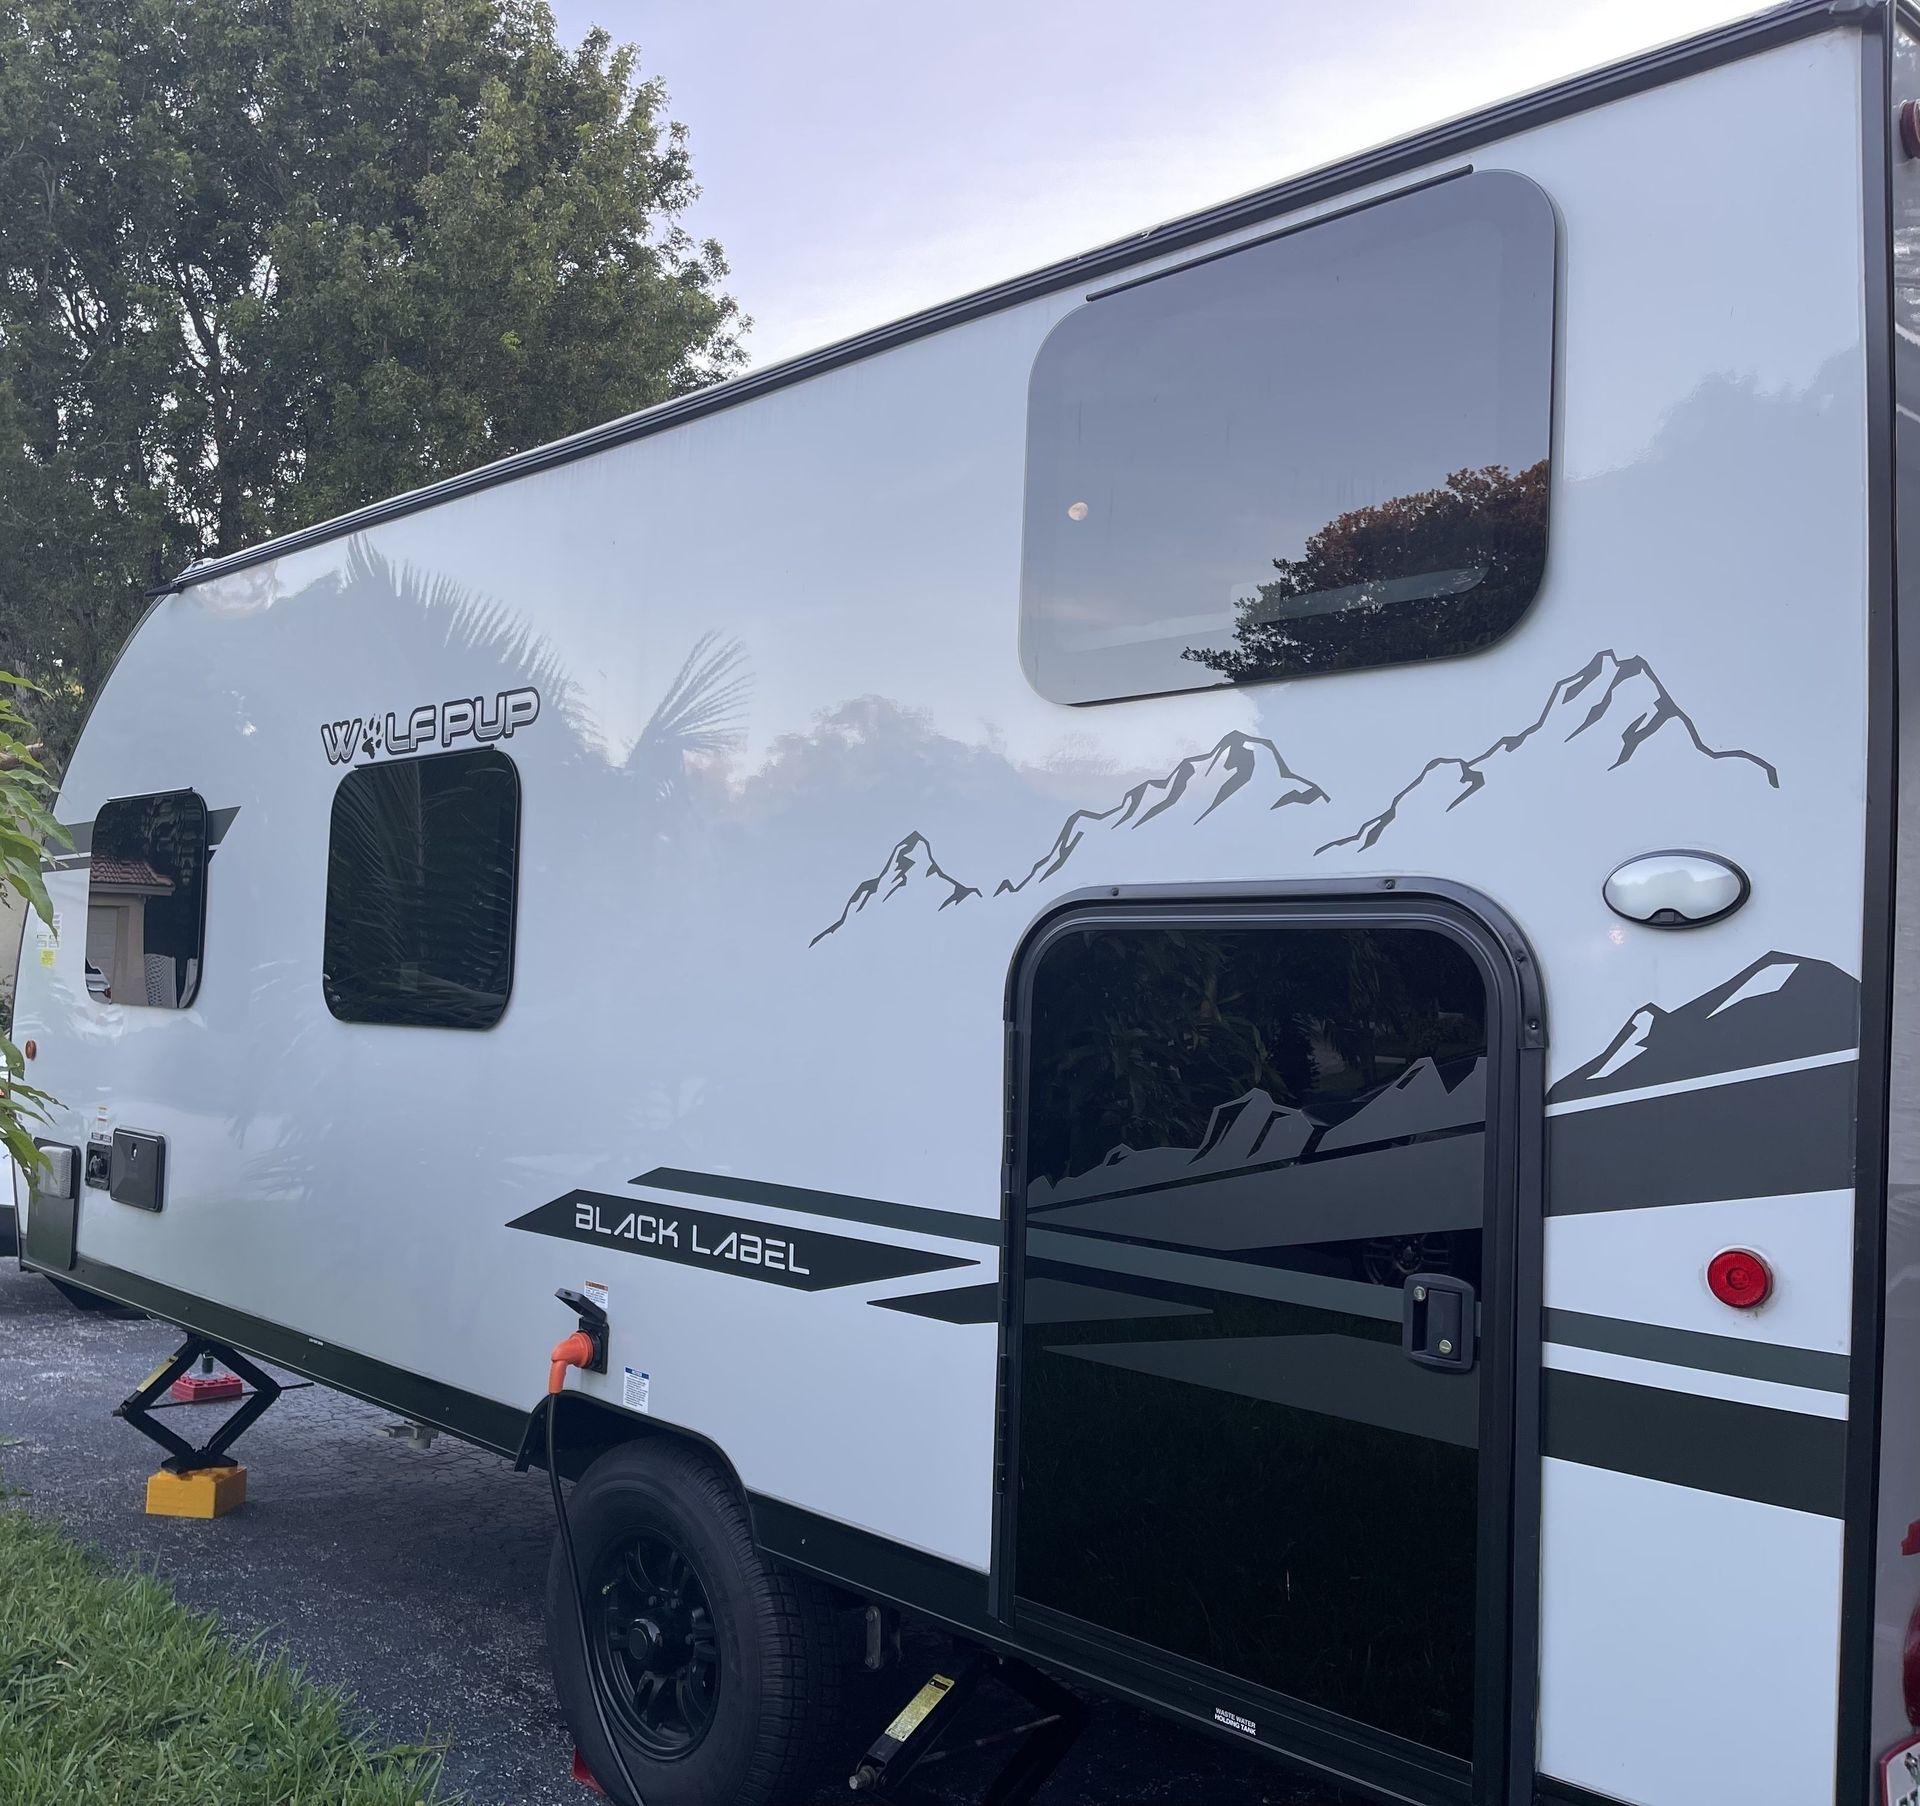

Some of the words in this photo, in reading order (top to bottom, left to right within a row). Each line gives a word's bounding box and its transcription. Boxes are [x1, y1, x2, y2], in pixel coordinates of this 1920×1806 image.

[321, 704, 436, 765] WLF
[442, 686, 540, 748] PUP
[575, 1203, 679, 1248] BLACK
[692, 1224, 810, 1275] LABEL
[1214, 1713, 1240, 1728] HOLDING
[1240, 1724, 1256, 1735] TANK
[1215, 1707, 1235, 1720] WASTE
[1235, 1715, 1256, 1729] WATER
